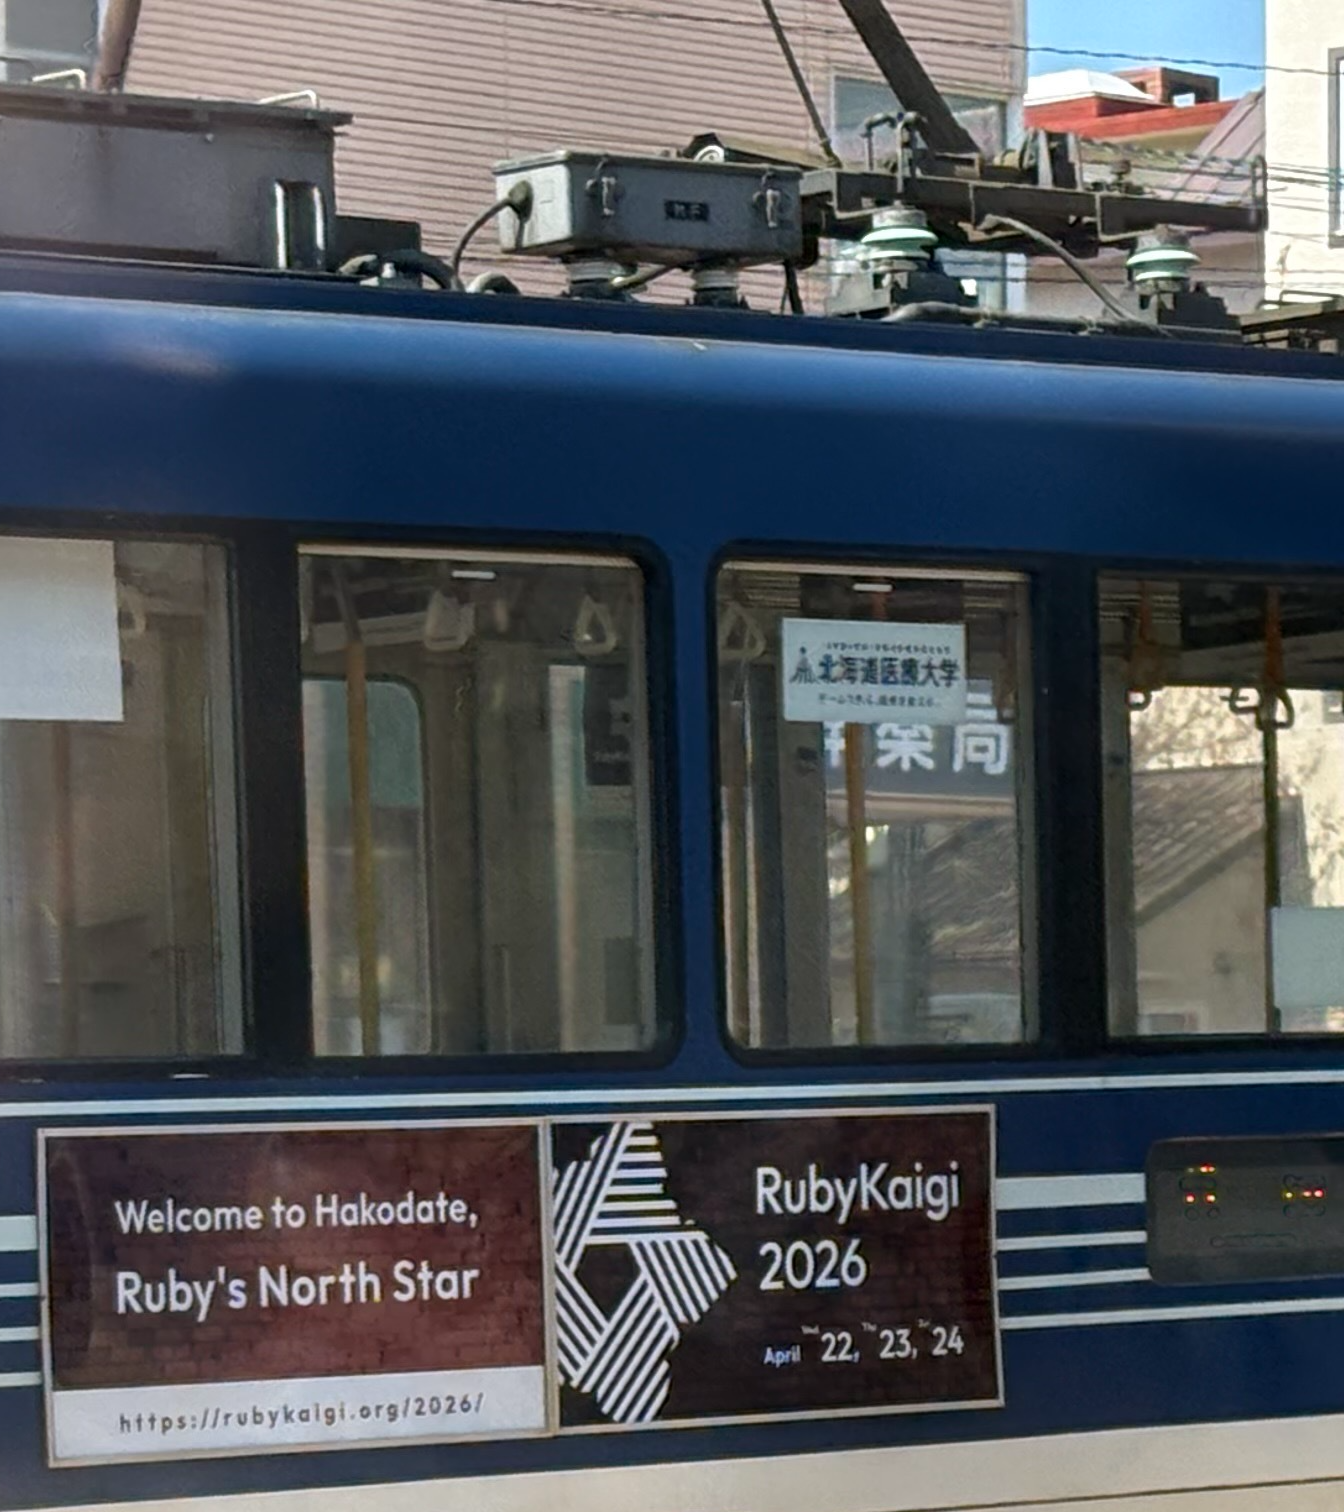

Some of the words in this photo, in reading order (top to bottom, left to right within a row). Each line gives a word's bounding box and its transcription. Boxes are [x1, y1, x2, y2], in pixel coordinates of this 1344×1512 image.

[114, 1198, 264, 1235] Welcome
[271, 1196, 306, 1228] to
[315, 1190, 479, 1229] Hakodate,
[757, 1160, 960, 1225] RubyKaigi
[759, 1239, 867, 1291] 2026
[116, 1265, 248, 1323] Ruby's
[259, 1260, 382, 1308] North
[392, 1259, 480, 1302] Star
[763, 1345, 801, 1369] April
[821, 1331, 860, 1363] 22,
[879, 1328, 918, 1360] 23,
[932, 1326, 964, 1356] 24
[119, 1393, 484, 1435] https://rubykaigi.org/2026/
